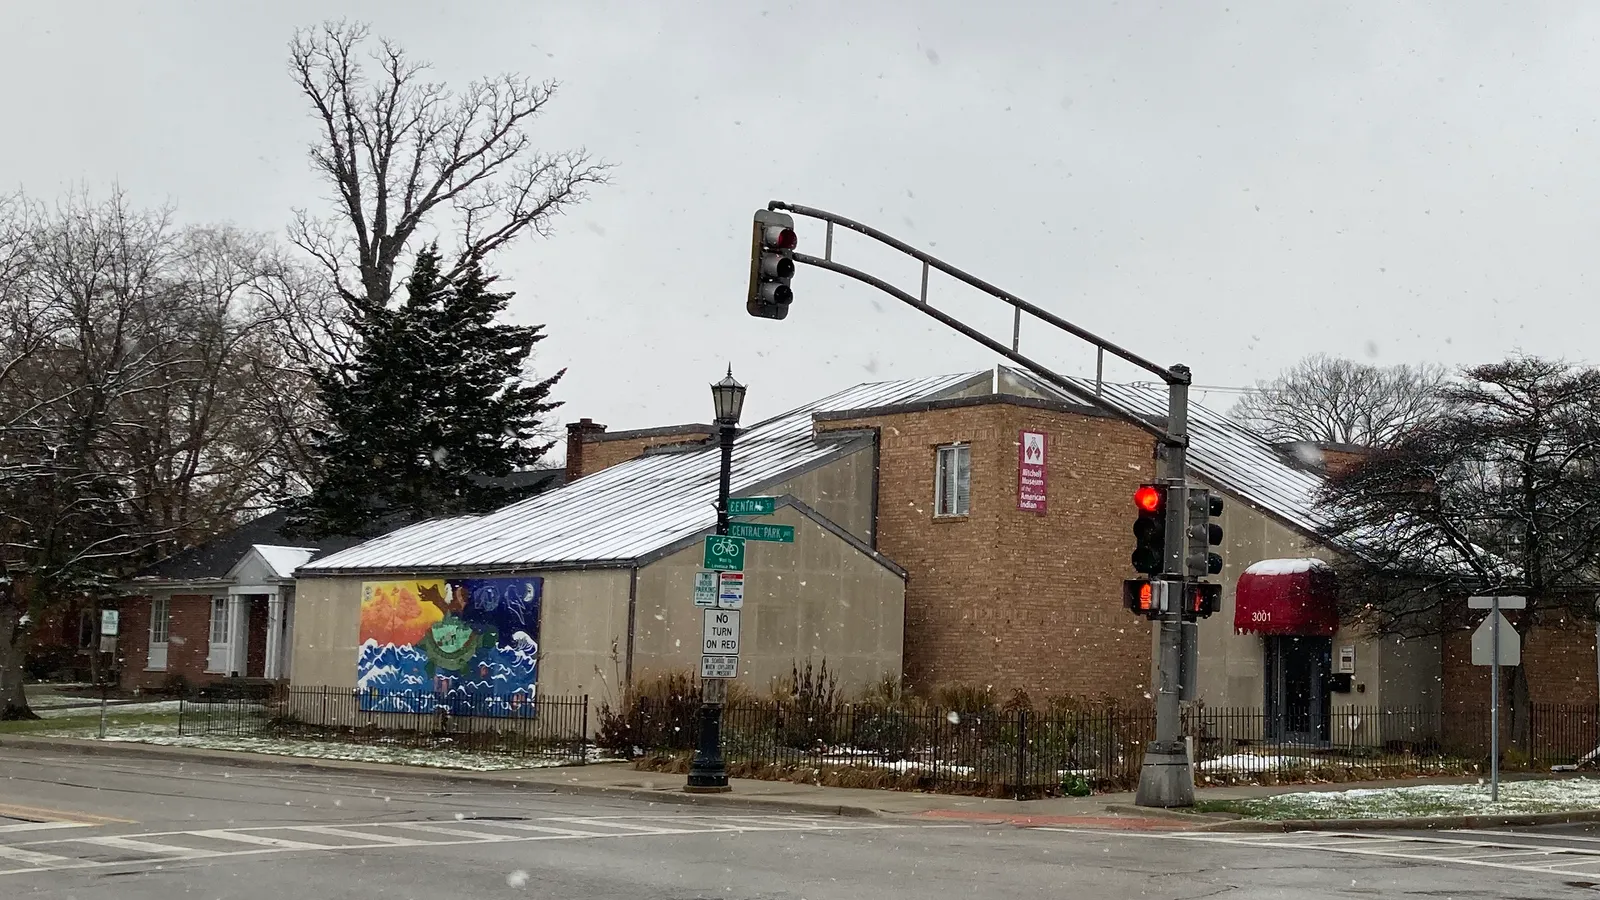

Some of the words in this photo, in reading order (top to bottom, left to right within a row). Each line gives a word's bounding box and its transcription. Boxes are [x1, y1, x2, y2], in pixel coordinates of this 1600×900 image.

[1022, 468, 1042, 477] Mitchell
[1022, 477, 1044, 486] Museum
[1021, 492, 1045, 501] American
[731, 500, 762, 512] CENTRAL
[732, 526, 760, 537] CENTRAL
[764, 527, 780, 538] PARK
[716, 614, 728, 623] NO
[1252, 611, 1271, 621] 3001
[712, 627, 732, 636] TURN
[706, 640, 717, 648] ON
[722, 640, 736, 649] RED
